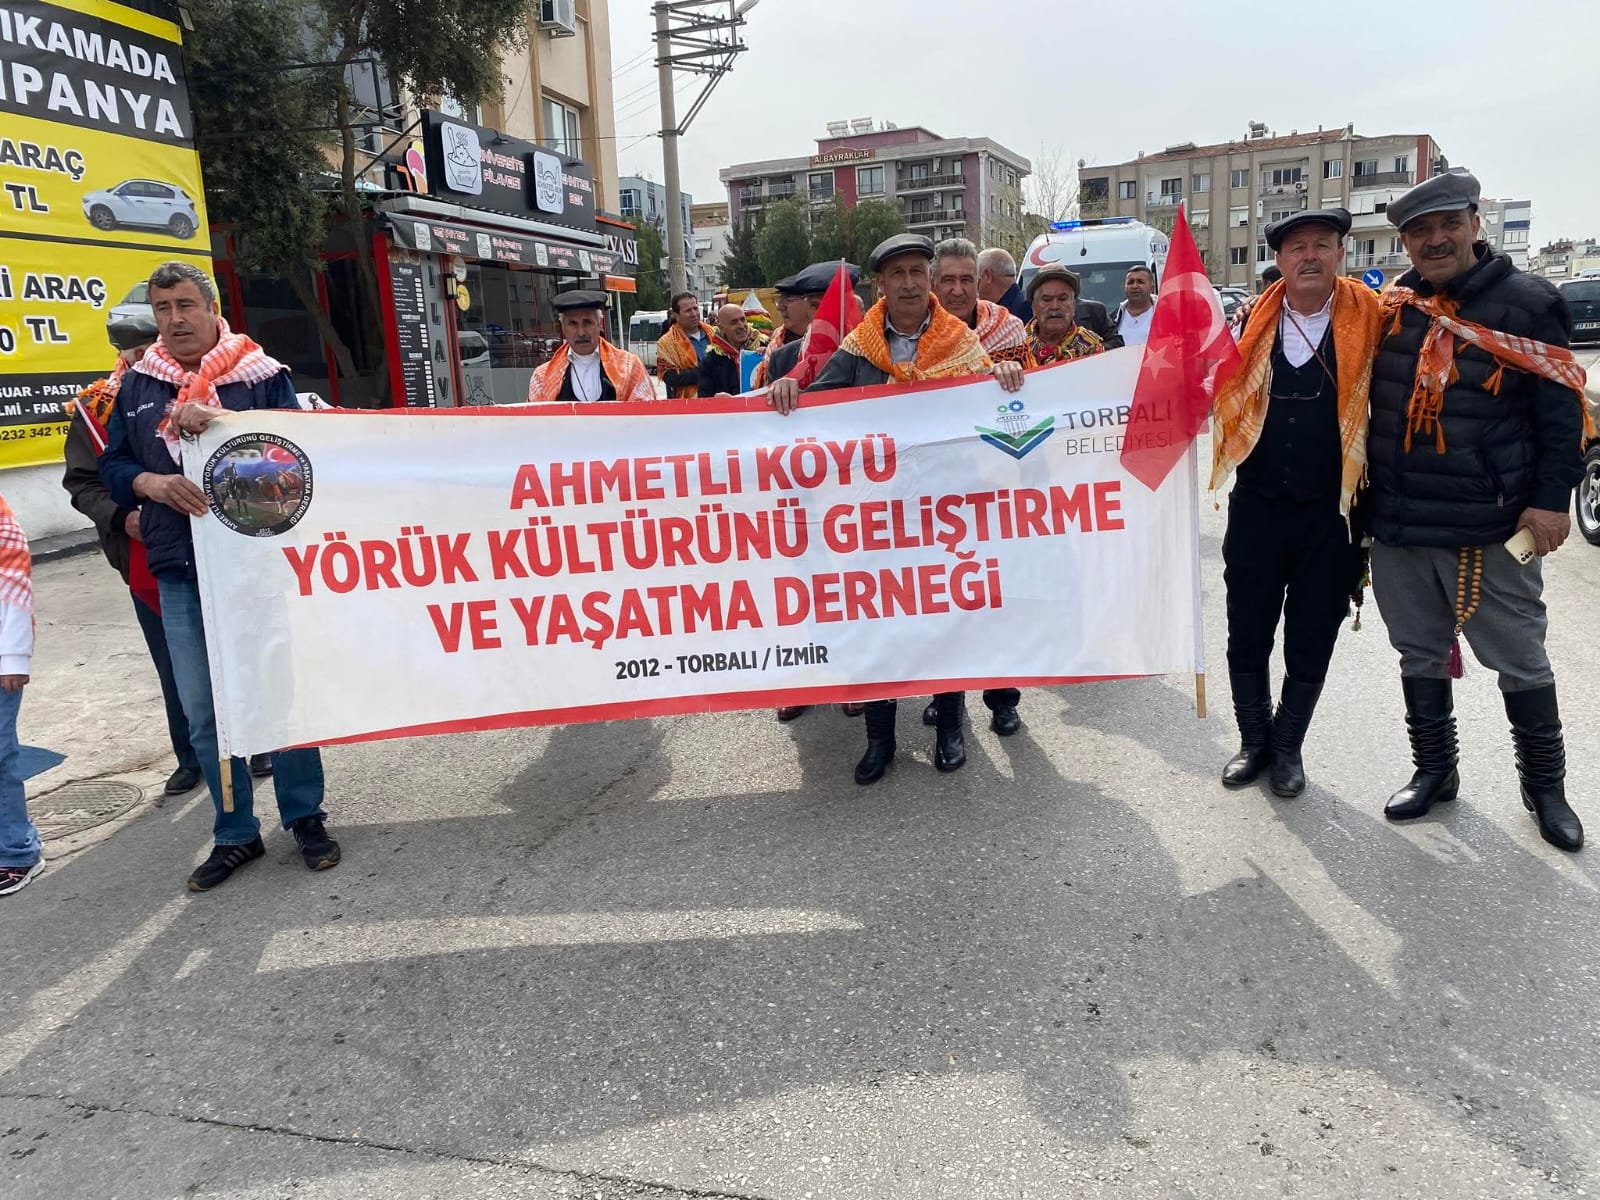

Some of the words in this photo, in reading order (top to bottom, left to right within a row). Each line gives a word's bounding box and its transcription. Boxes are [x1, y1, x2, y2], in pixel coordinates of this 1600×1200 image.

[0, 139, 85, 180] ARAÇ
[814, 151, 869, 164] ALBAYRAKLAR
[5, 183, 48, 212] TL
[0, 268, 13, 298] İ
[24, 275, 106, 307] ARAÇ
[26, 318, 68, 341] TL
[43, 384, 82, 396] PASTA
[33, 402, 60, 414] FAR
[1062, 399, 1172, 430] TORBALI
[0, 429, 26, 441] 232
[30, 427, 51, 438] 342
[510, 449, 742, 509] AHMETLİ
[756, 433, 897, 491] KÖYÜ
[281, 525, 479, 596] YÖRÜK
[487, 497, 809, 580] KÜLTÜRÜNÜ
[823, 480, 1126, 554] GELİŞTİRME
[427, 599, 502, 653] VE
[509, 580, 763, 650] YAŞATMA
[773, 549, 1003, 627] DERNEĞİ
[615, 657, 660, 680] 2012
[676, 649, 758, 674] TORBALI
[775, 641, 829, 668] İZMİR
